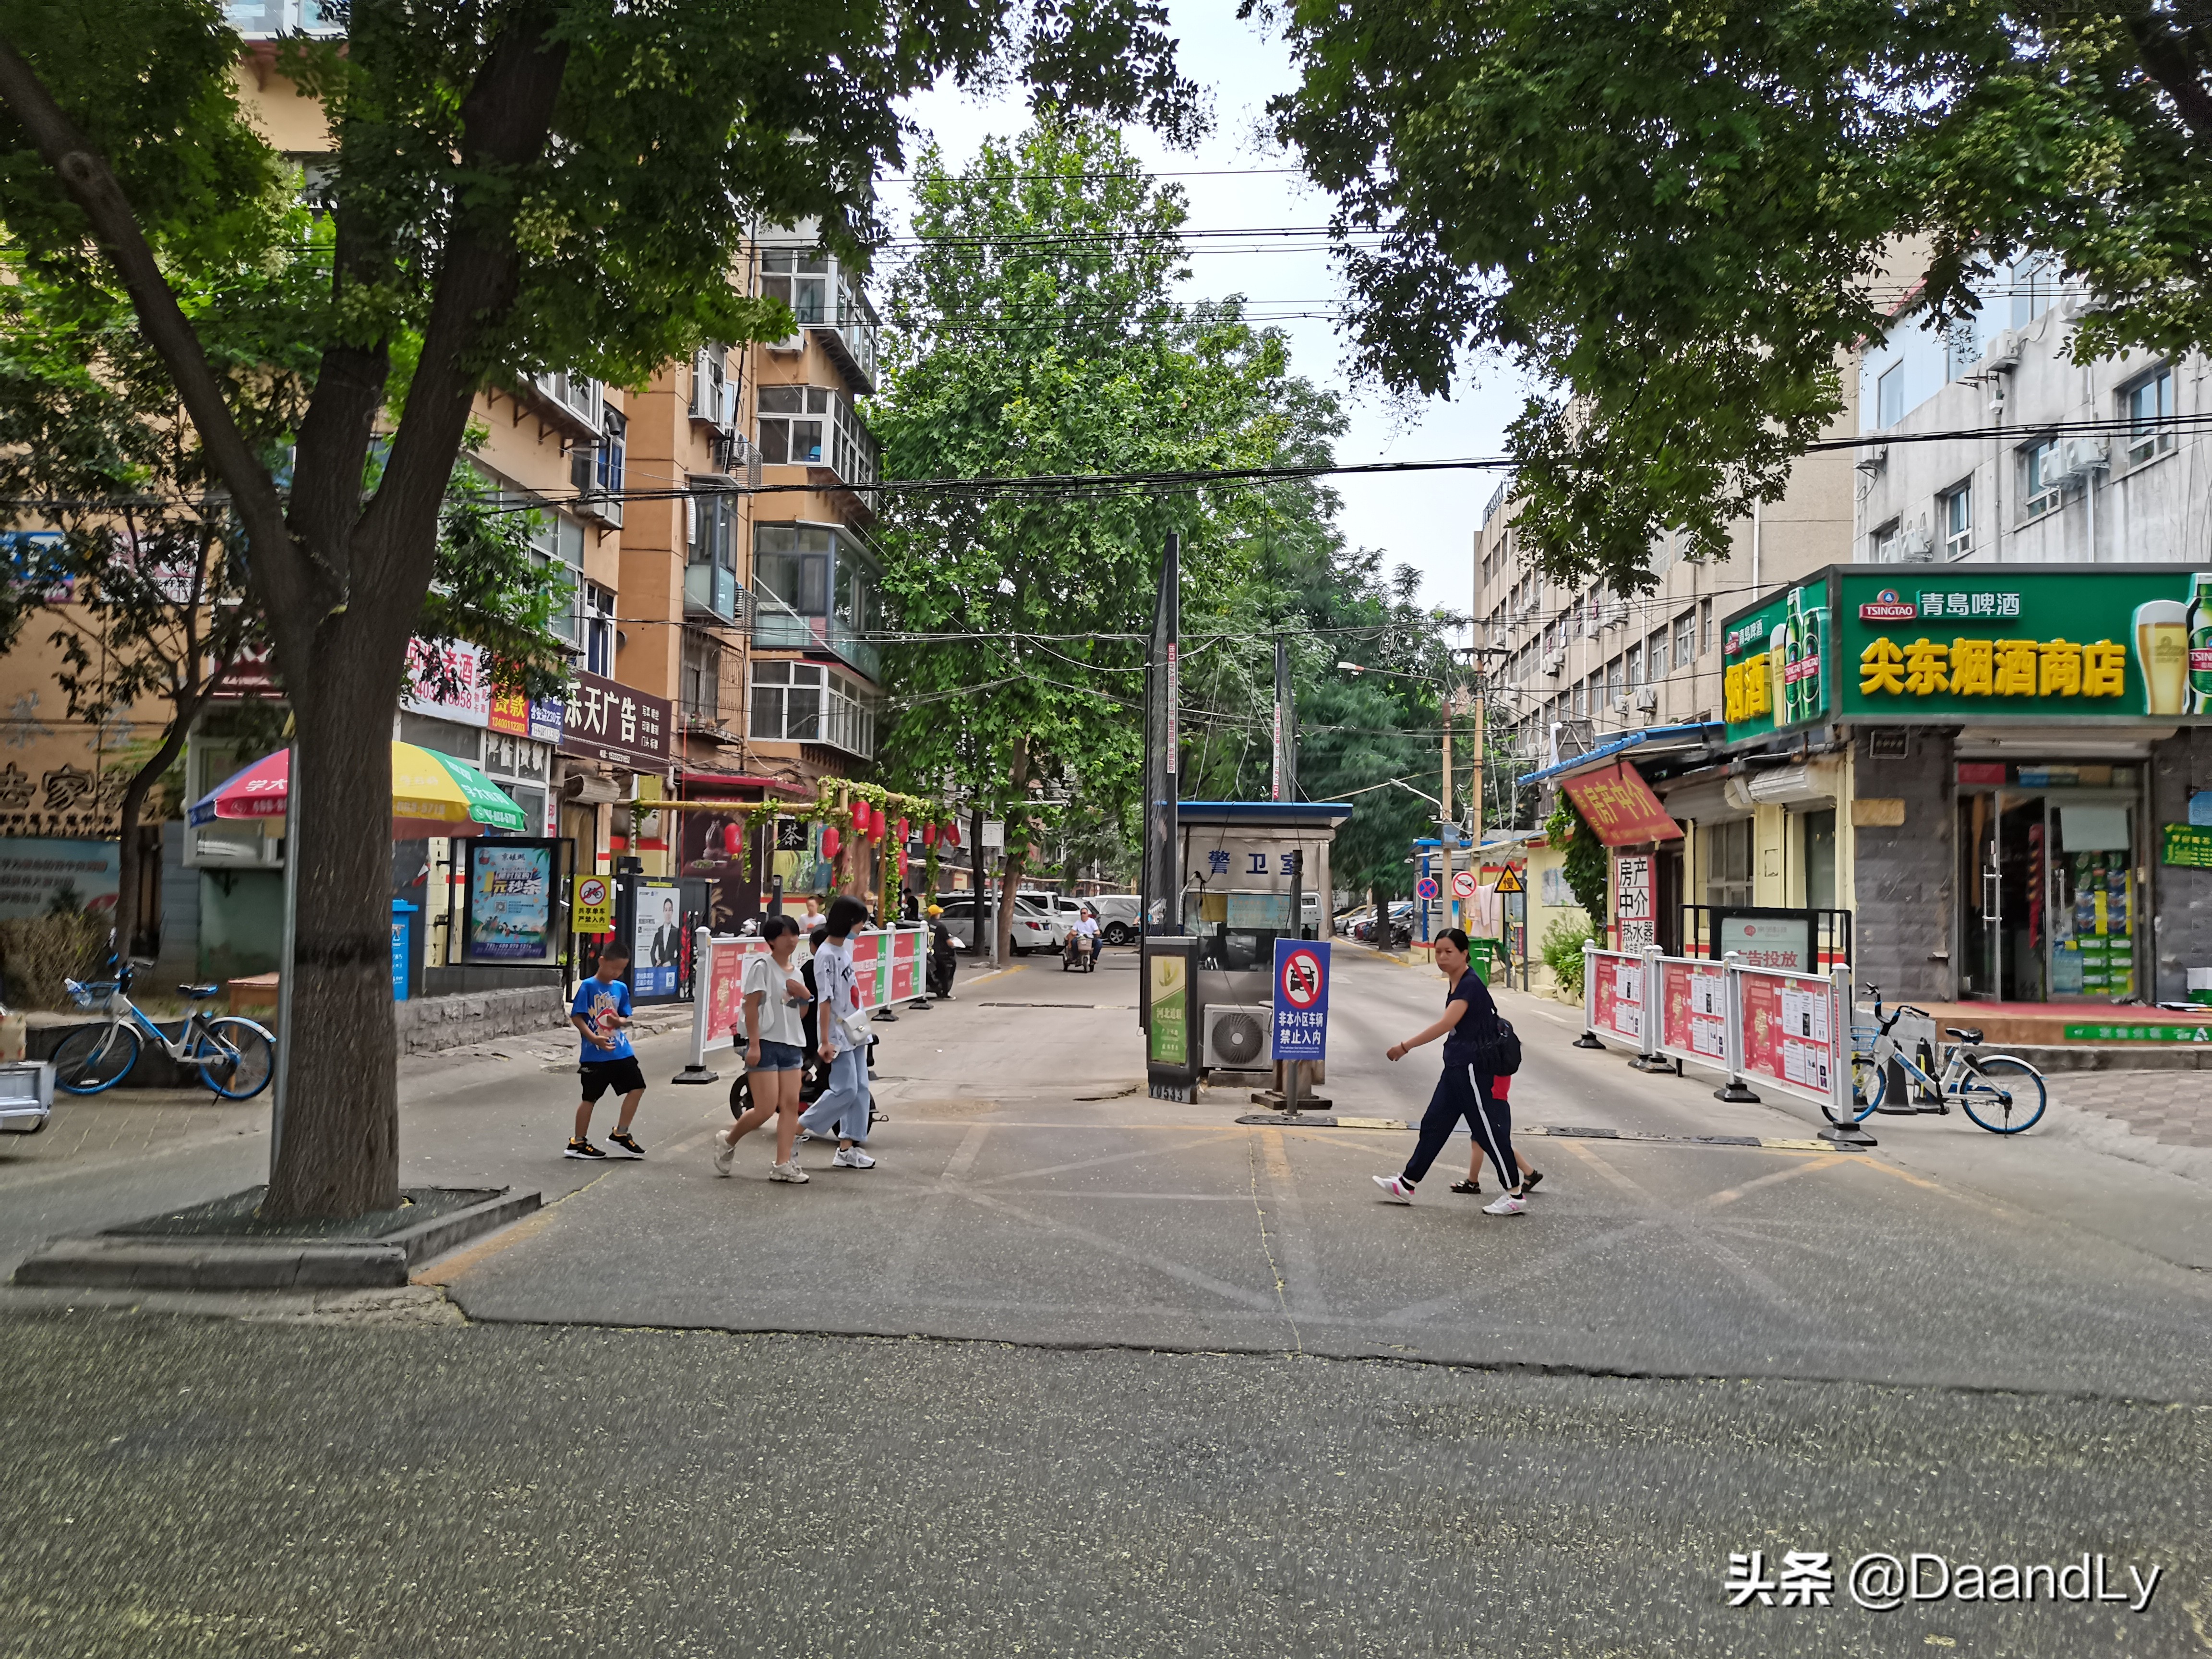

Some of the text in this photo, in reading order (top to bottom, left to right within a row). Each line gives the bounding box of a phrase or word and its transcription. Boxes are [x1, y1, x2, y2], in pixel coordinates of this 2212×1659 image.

[1866, 592, 2020, 616] TSINGTAO 青岛啤酒
[1739, 618, 1763, 645] 青岛啤酒
[1169, 645, 1175, 659] 出口
[1859, 637, 2126, 698] 尖东烟酒商店
[1725, 653, 1767, 724] 烟酒
[565, 681, 637, 743] 乐天广告
[1583, 774, 1657, 825] 房产中介
[781, 822, 804, 847] 茶
[1208, 850, 1294, 876] 警卫室
[1619, 858, 1648, 887] 房产
[1503, 878, 1515, 890] 慢
[1620, 888, 1648, 917] 中介
[1623, 920, 1653, 943] 热水器
[1278, 1010, 1323, 1028] 非本小区车辆
[1280, 1028, 1321, 1045] 禁止入内
